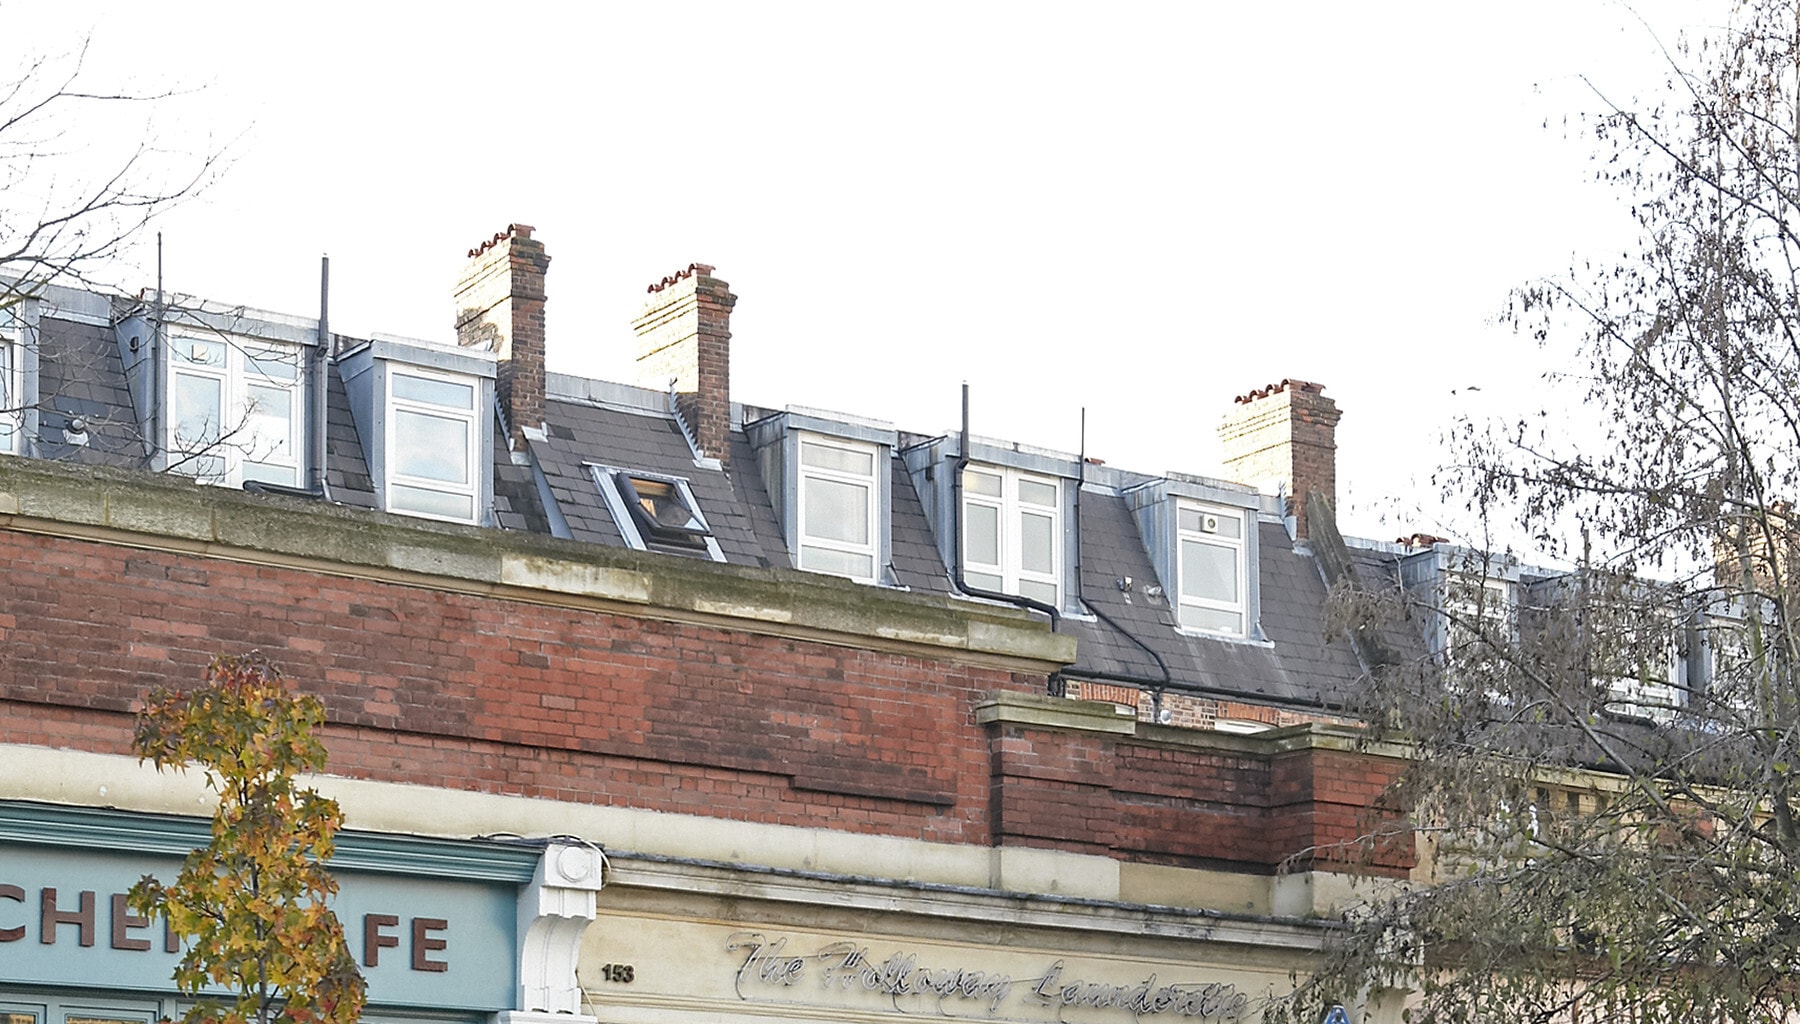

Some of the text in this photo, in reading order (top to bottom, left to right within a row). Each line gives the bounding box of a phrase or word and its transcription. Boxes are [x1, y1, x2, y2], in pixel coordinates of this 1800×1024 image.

[602, 963, 635, 983] 153
[725, 932, 1248, 1017] The Holloway Launderette
